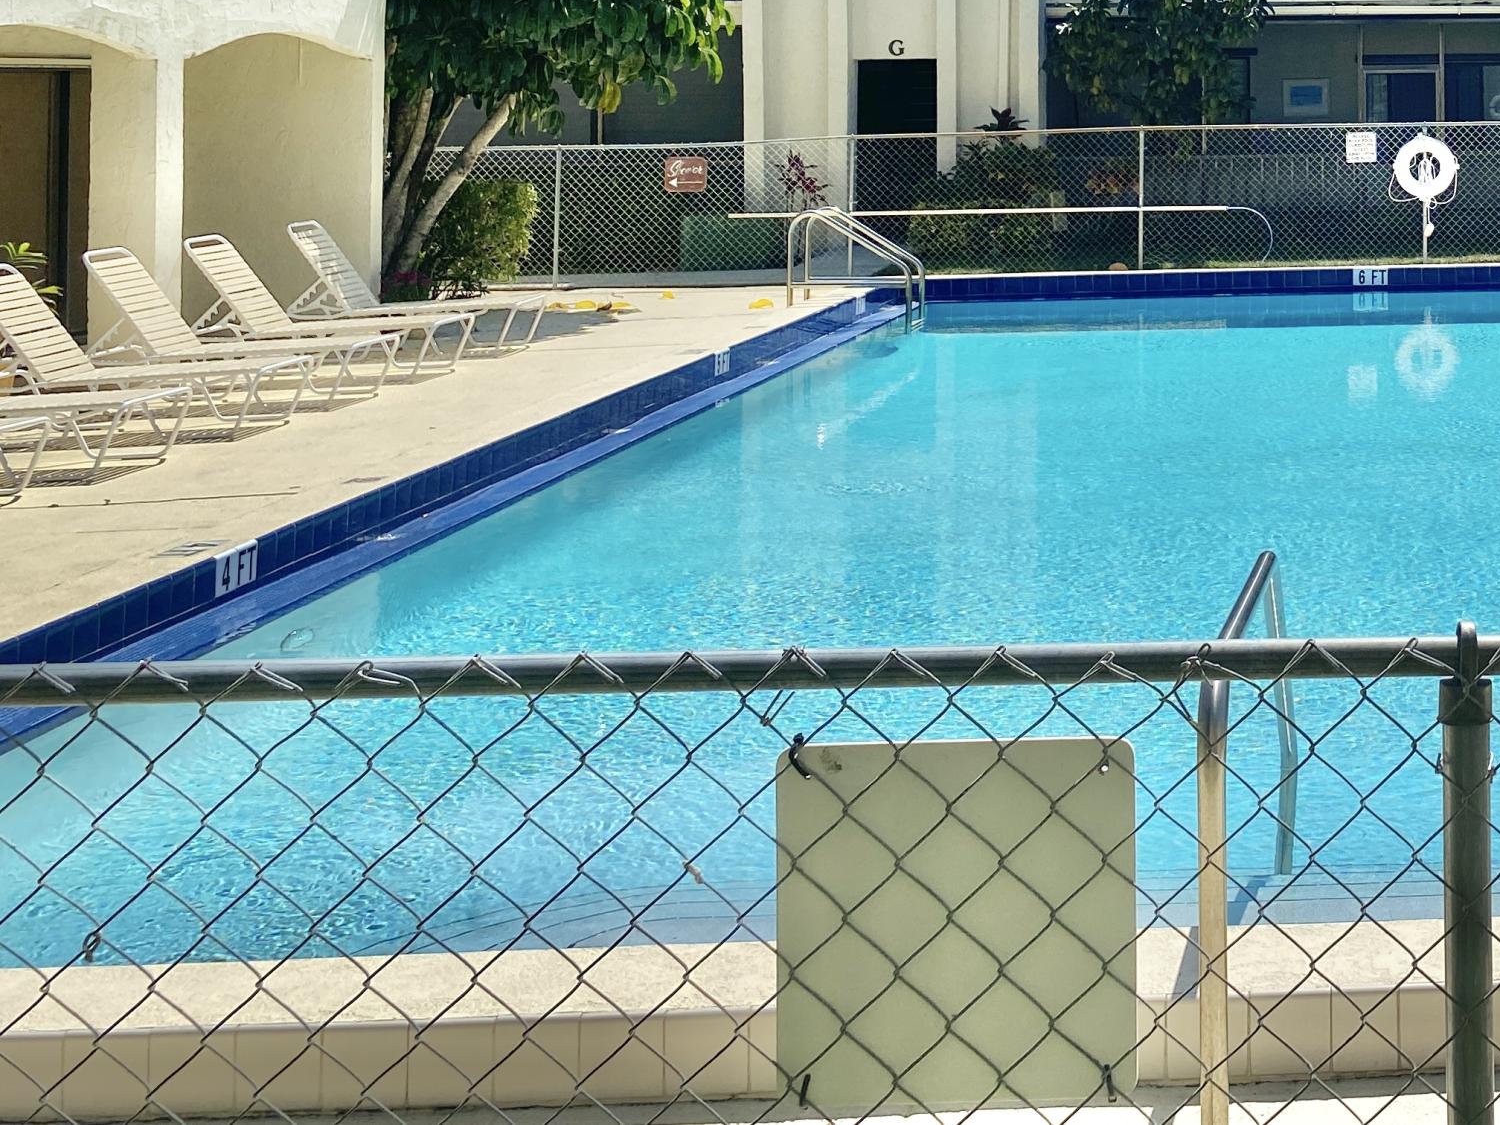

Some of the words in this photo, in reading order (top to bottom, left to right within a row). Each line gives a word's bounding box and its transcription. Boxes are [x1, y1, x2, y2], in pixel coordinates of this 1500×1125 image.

[888, 39, 905, 56] G
[1358, 269, 1366, 285] 6
[1371, 269, 1387, 285] FT
[221, 555, 231, 591] 4
[237, 544, 257, 586] FT
